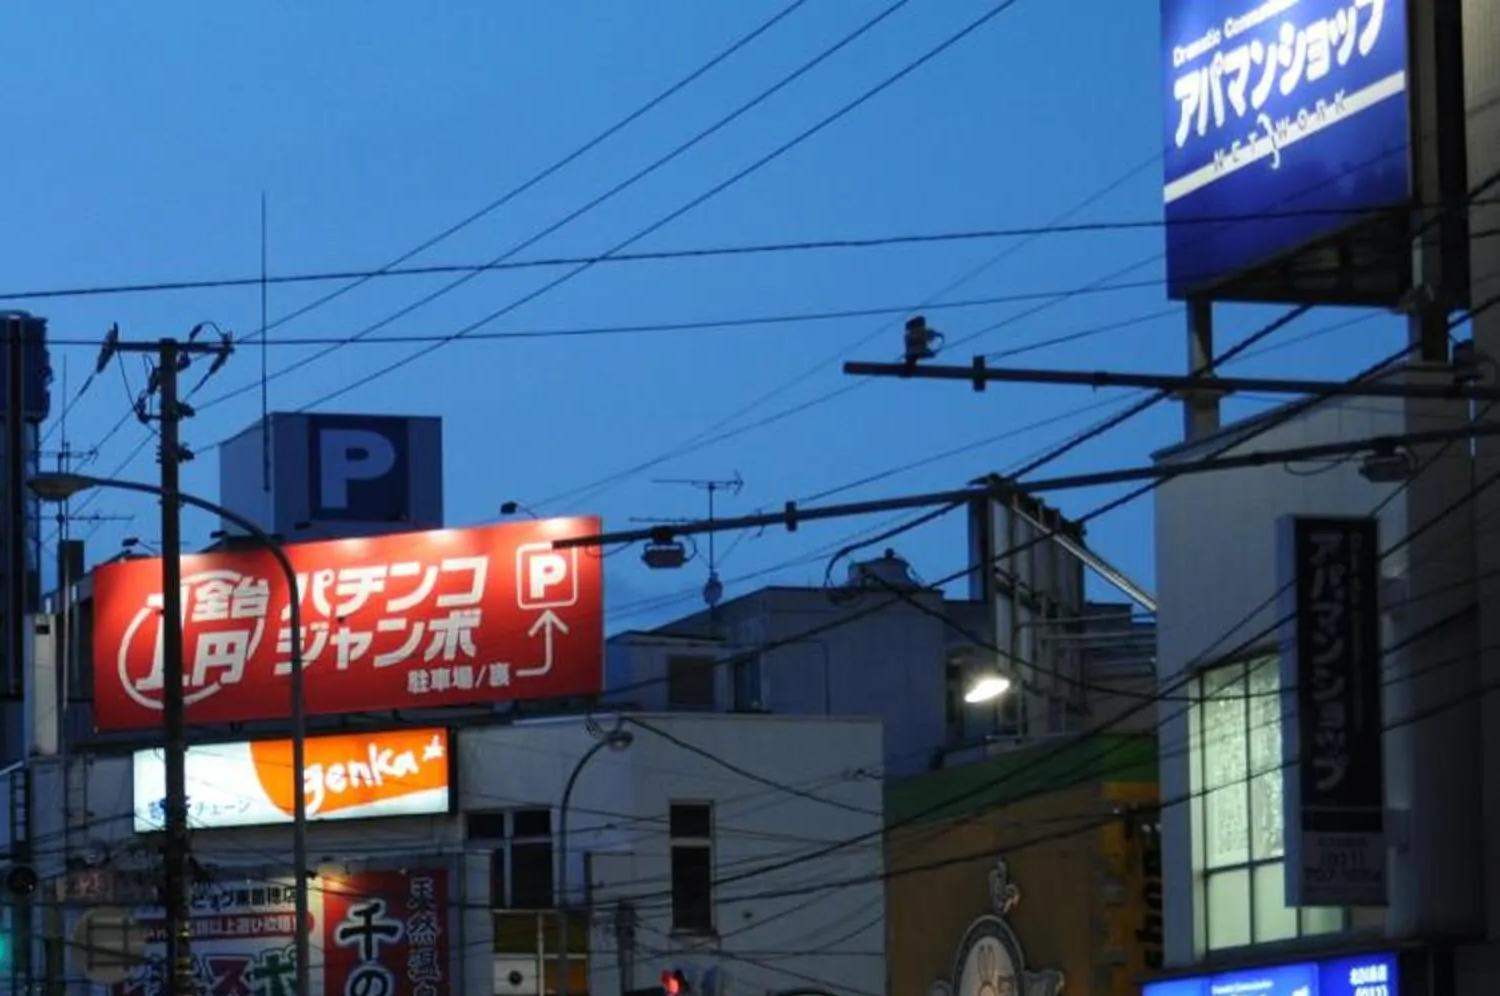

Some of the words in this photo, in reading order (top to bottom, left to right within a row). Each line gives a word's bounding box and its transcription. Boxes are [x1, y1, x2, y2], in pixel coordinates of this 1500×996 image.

[318, 428, 396, 508] P
[281, 556, 489, 619] パチンコ
[529, 555, 567, 600] P
[274, 608, 482, 677] ジャンボ
[301, 743, 419, 820] genka
